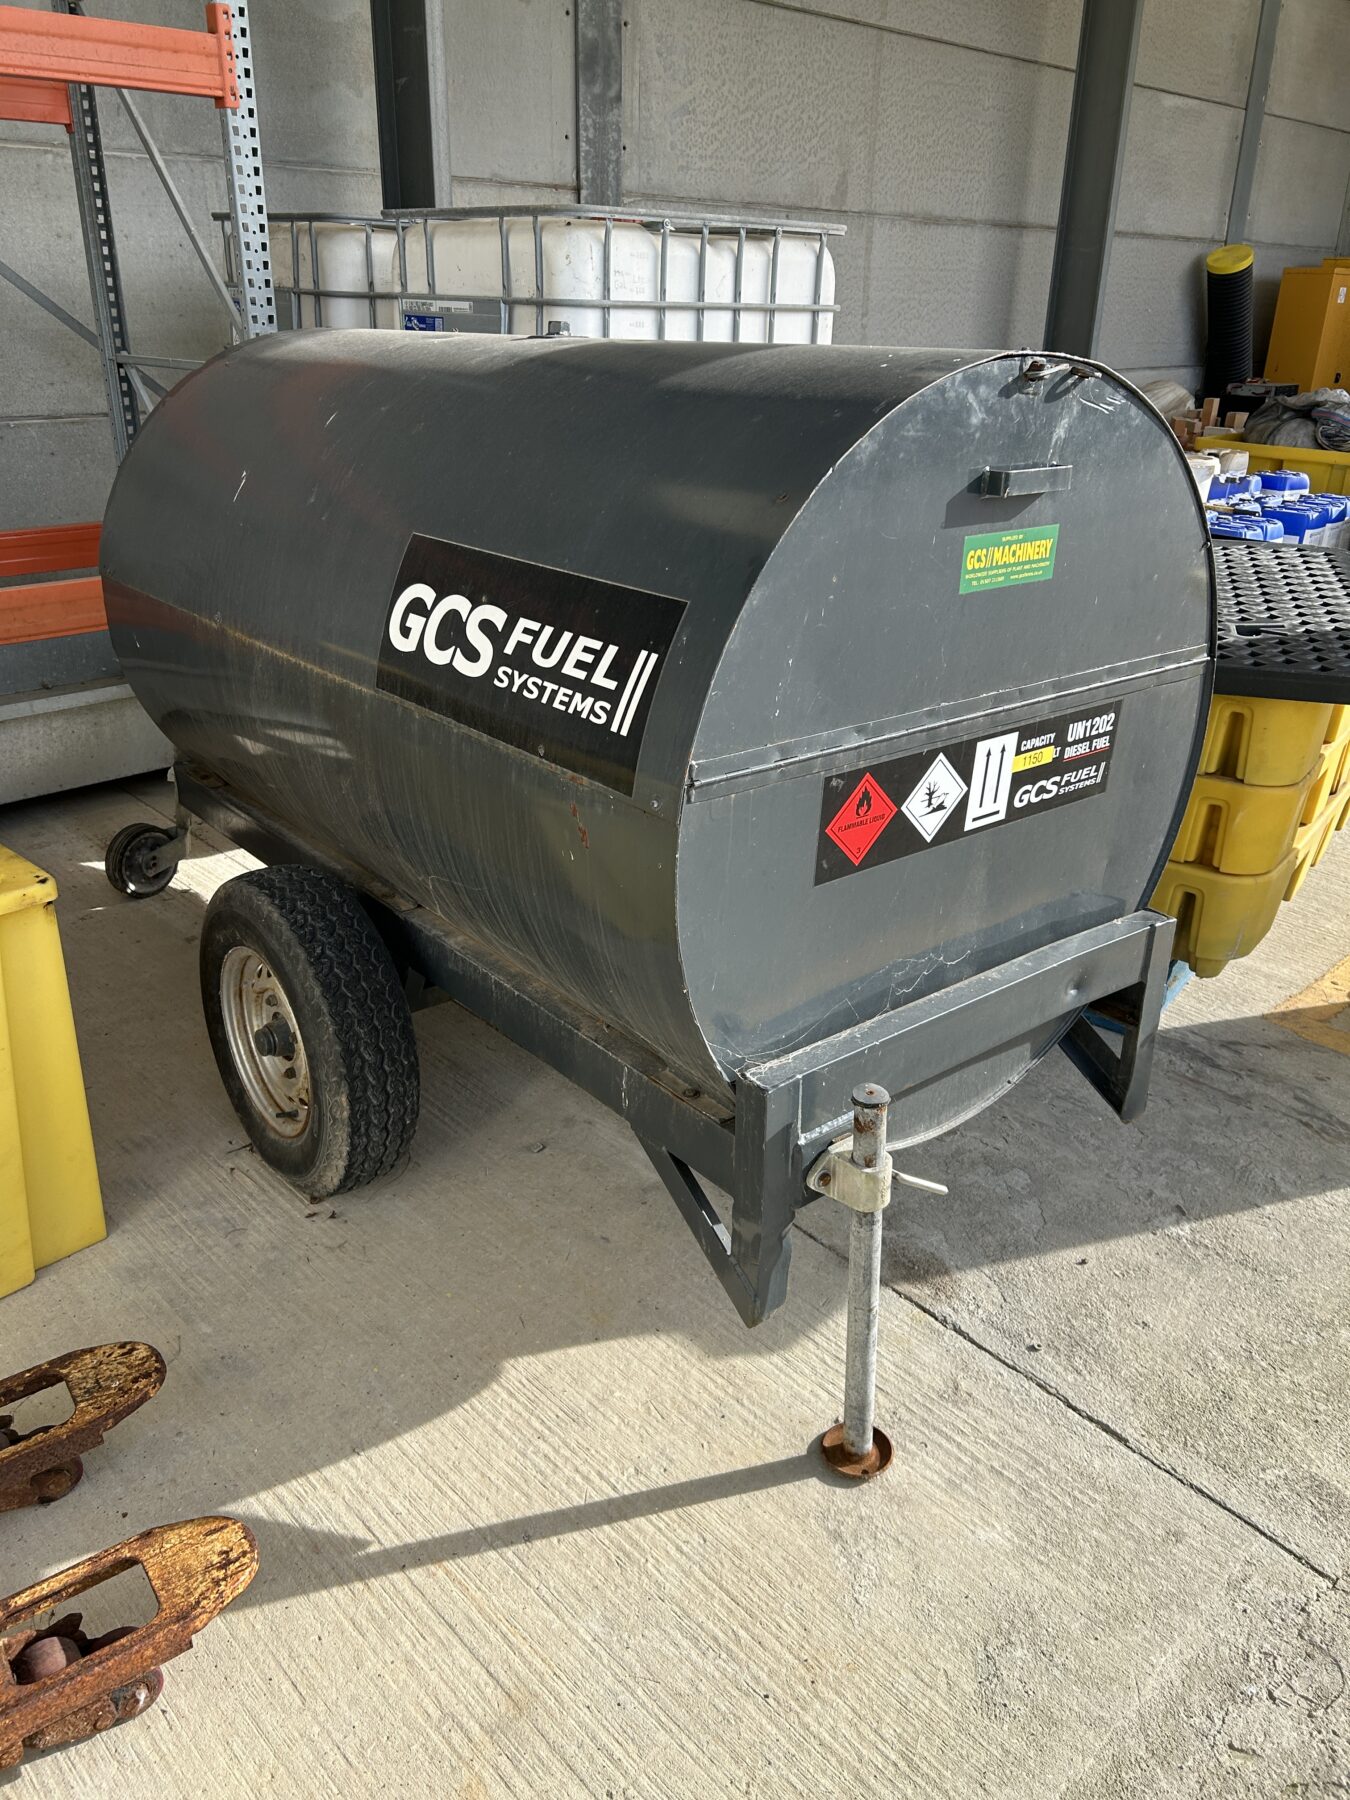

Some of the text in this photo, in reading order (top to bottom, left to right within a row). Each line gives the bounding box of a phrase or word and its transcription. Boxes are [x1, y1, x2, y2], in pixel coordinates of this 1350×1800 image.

[388, 582, 508, 678] GCS
[503, 617, 619, 690] FUEL
[493, 666, 612, 725] SYSTEMS
[1067, 713, 1115, 742] UN1202
[1021, 733, 1056, 751] CAPACITY
[1064, 736, 1110, 759] DIESEL FUEL
[1023, 751, 1043, 766] 1150
[1058, 778, 1096, 795] SYSTEMS
[1061, 765, 1098, 785] FUEL
[1013, 776, 1061, 808] GCS
[838, 814, 886, 833] FLAMMABLE LIQUID
